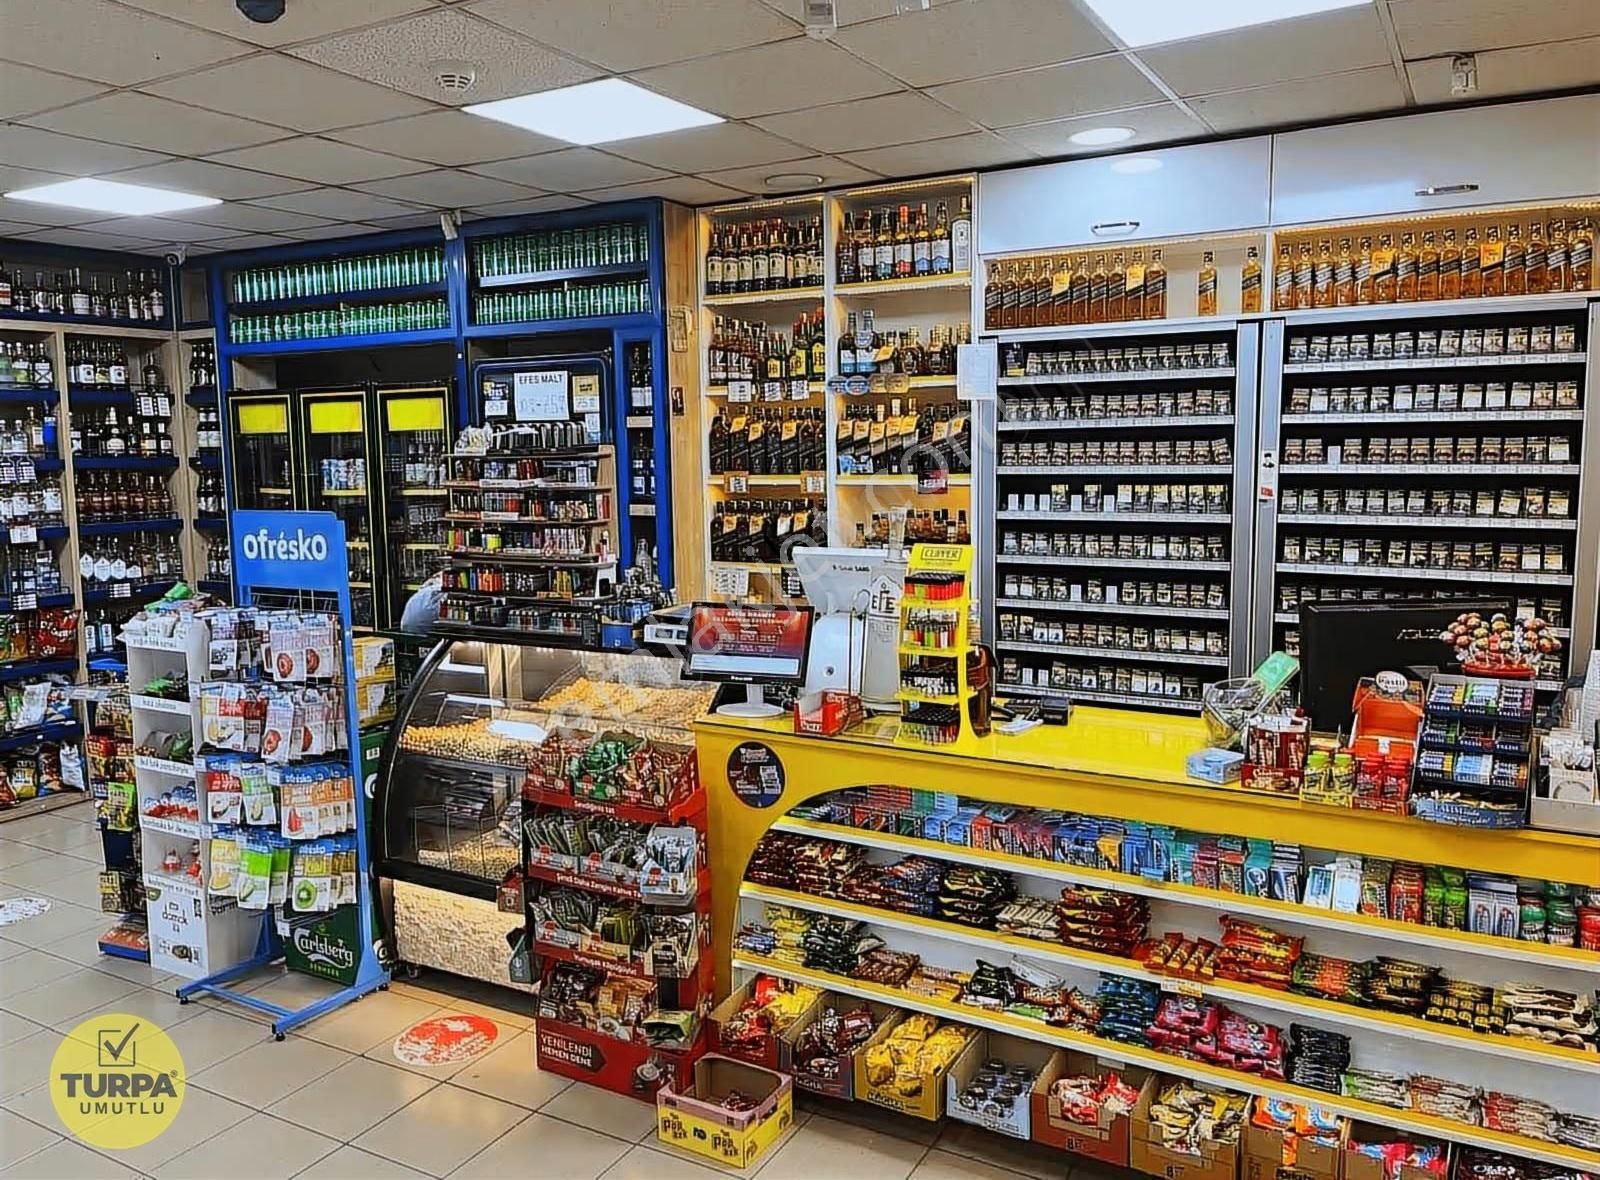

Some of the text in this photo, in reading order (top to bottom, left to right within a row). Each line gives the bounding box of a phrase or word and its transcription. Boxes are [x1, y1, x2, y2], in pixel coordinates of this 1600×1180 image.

[519, 373, 563, 384] EFES MALT
[243, 528, 328, 561] ofrésko
[294, 927, 353, 967] Carlsberg
[541, 1034, 593, 1057] YENİLENDİ
[541, 1046, 593, 1067] HEMEN DENE
